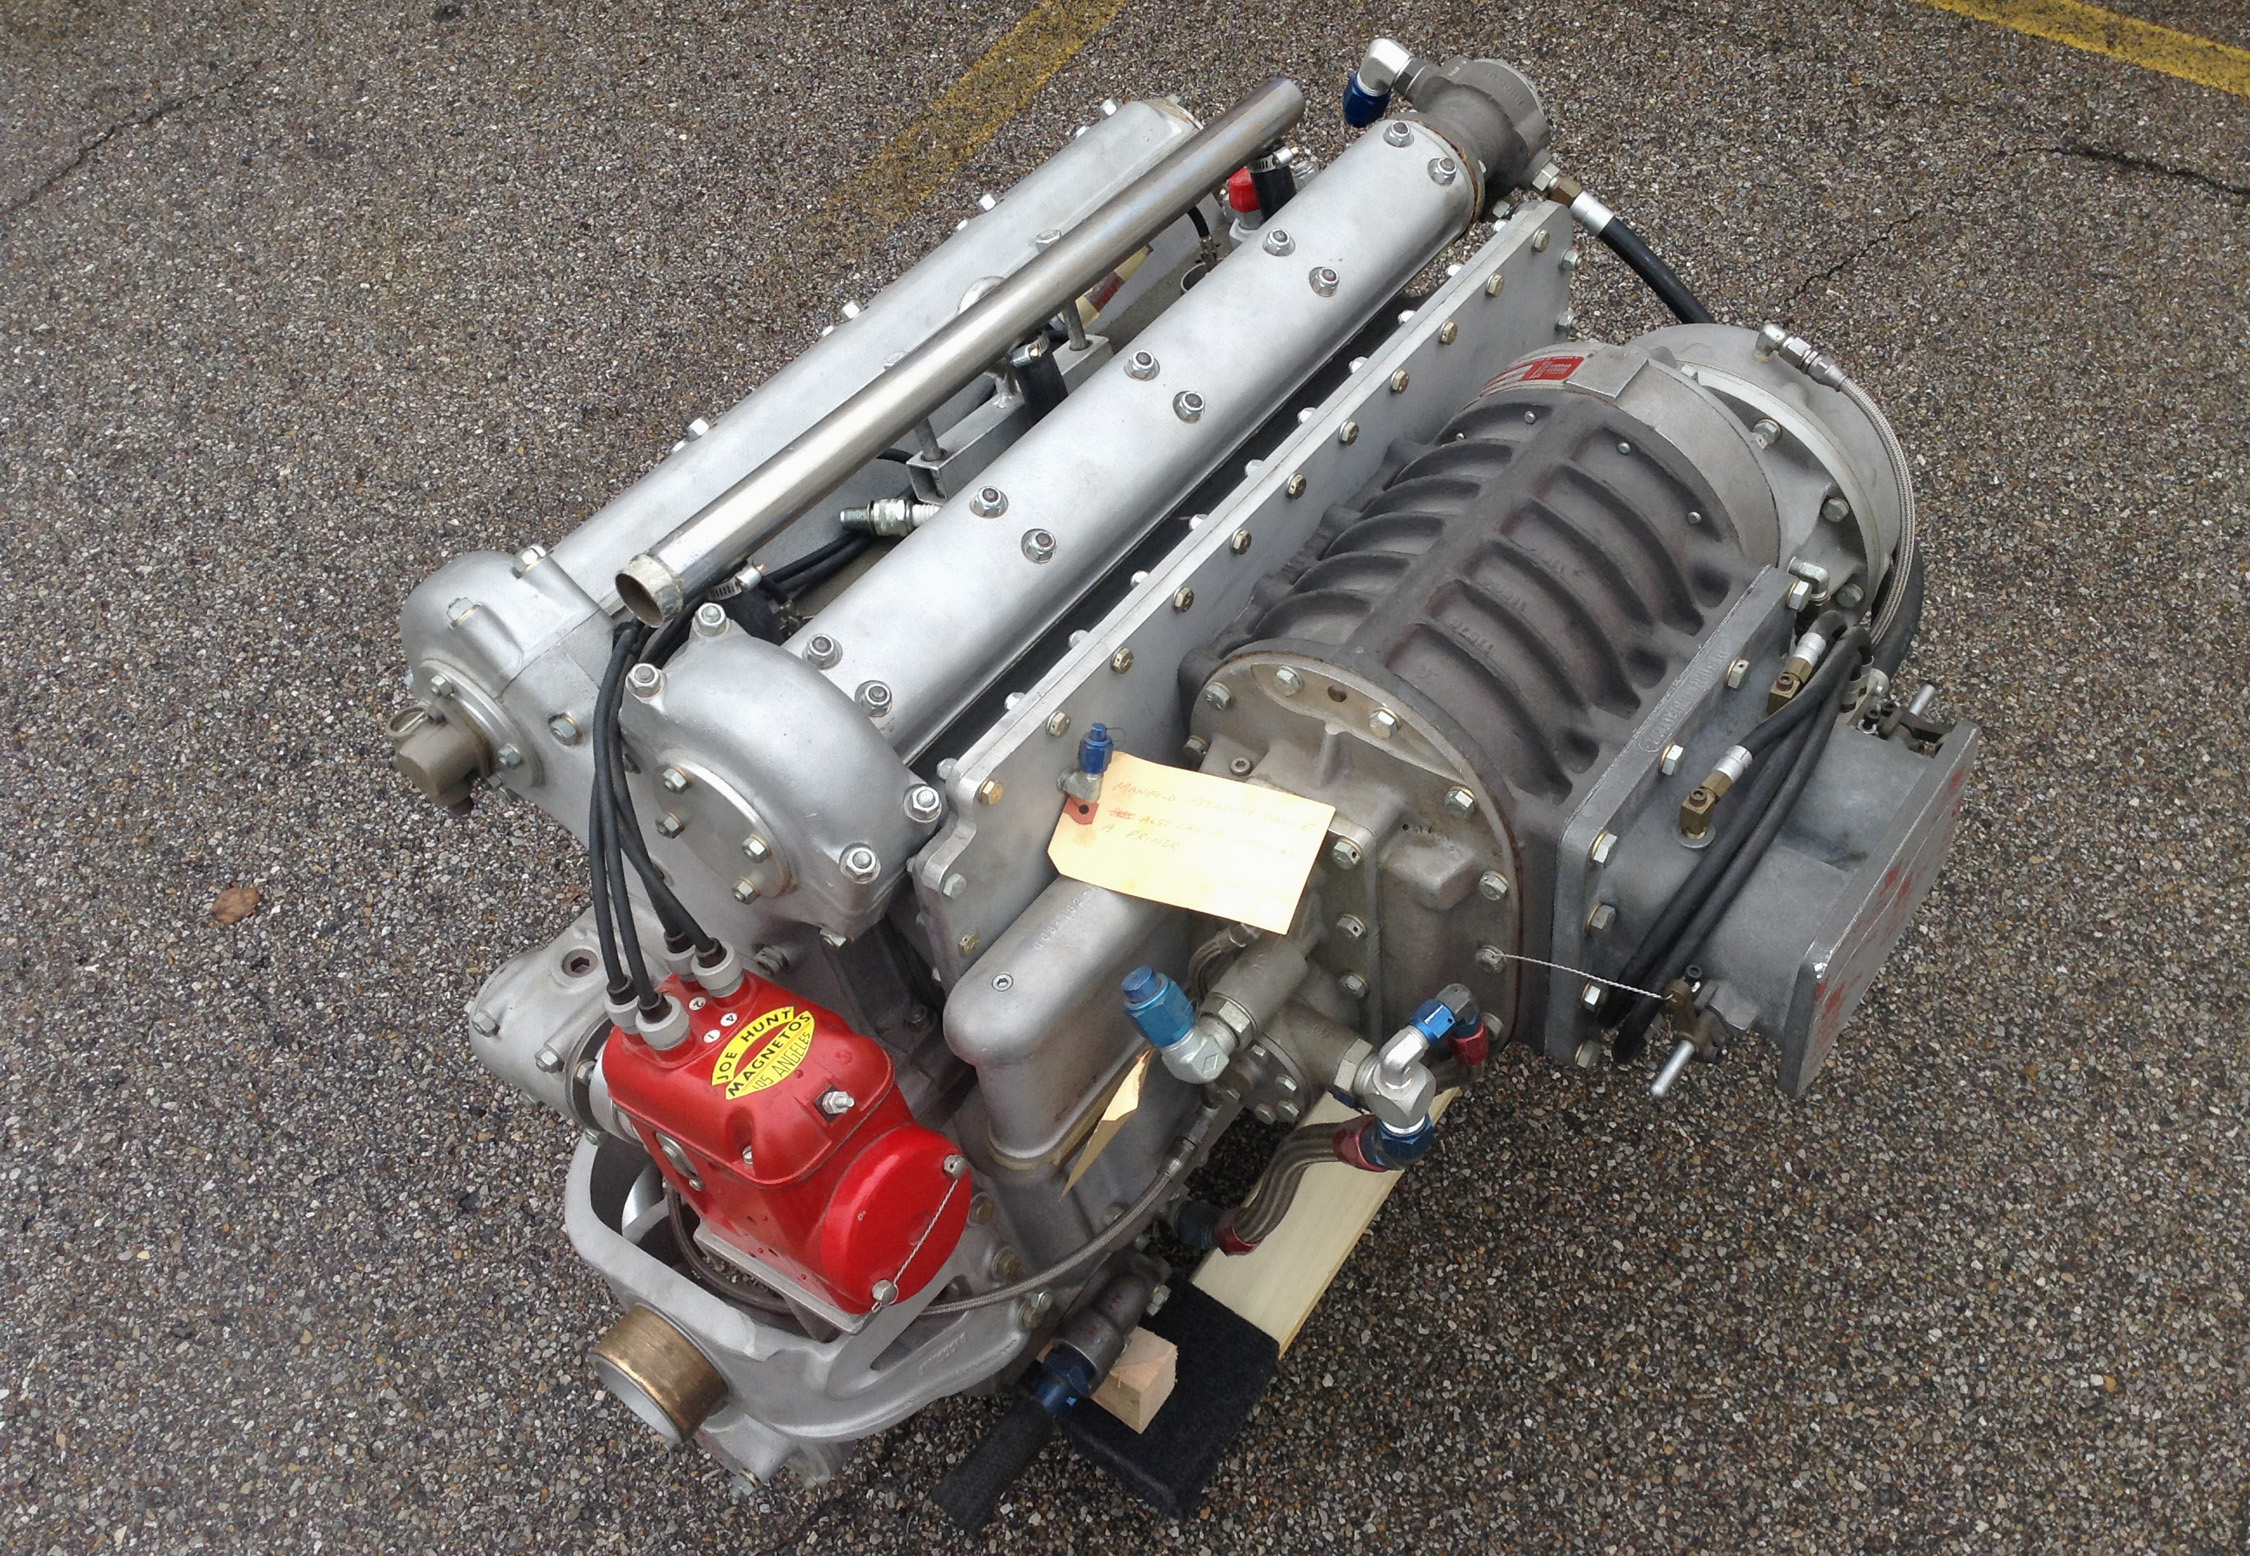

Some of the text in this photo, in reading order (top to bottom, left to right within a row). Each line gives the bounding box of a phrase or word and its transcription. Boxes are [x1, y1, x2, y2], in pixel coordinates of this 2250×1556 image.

[716, 1010, 791, 1081] JOE HUNT
[727, 1014, 811, 1097] MAGNETOS
[752, 1031, 811, 1090] LOS ANGELES
